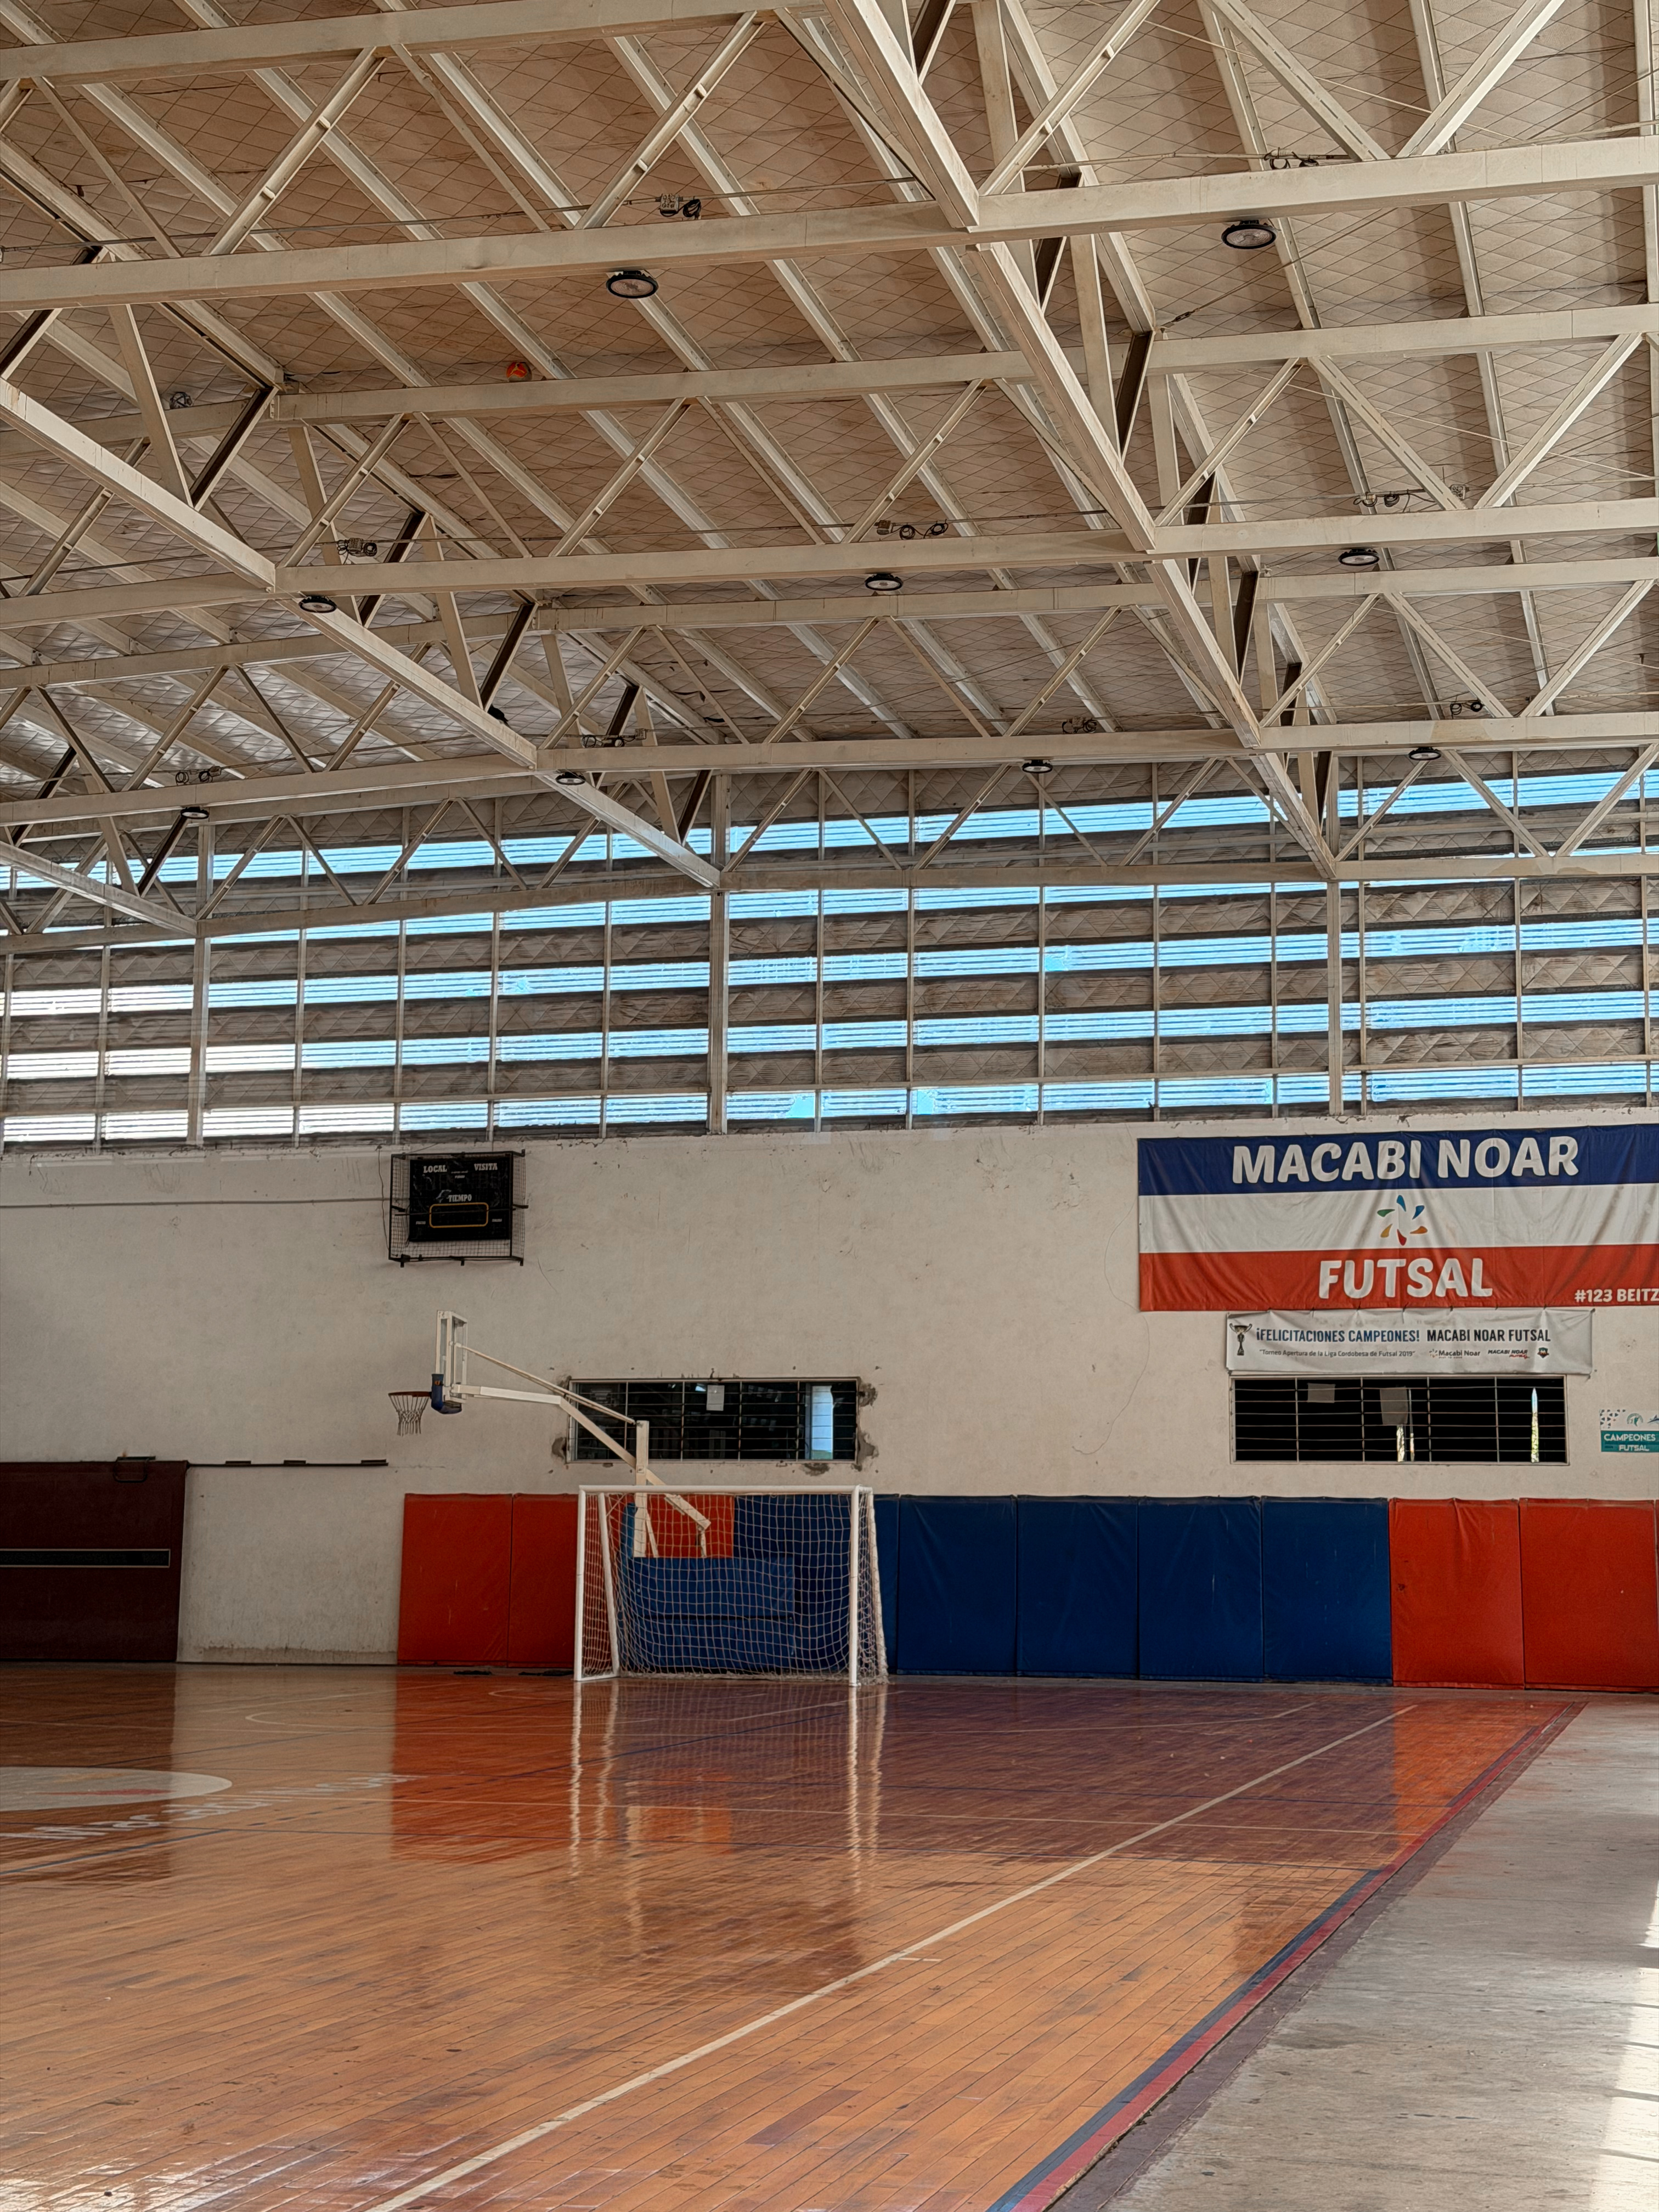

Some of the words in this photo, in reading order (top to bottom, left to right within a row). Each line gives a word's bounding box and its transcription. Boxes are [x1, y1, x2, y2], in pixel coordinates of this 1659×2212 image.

[1232, 1141, 1421, 1184] MACABI
[1438, 1136, 1579, 1178] NOAR
[424, 1165, 447, 1173] LOCAL
[1319, 1257, 1493, 1299] FUTSAL
[1575, 1289, 1612, 1303] #123
[1617, 1288, 1659, 1302] BEITZ
[1256, 1328, 1345, 1342] ¡FELICITACIONES
[1348, 1329, 1420, 1342] CAMPEONES!
[1427, 1329, 1470, 1342] MACABI
[1474, 1329, 1505, 1342] NOAR
[1509, 1329, 1551, 1342] FUTSAL
[1604, 1434, 1656, 1442] CAMPEONES
